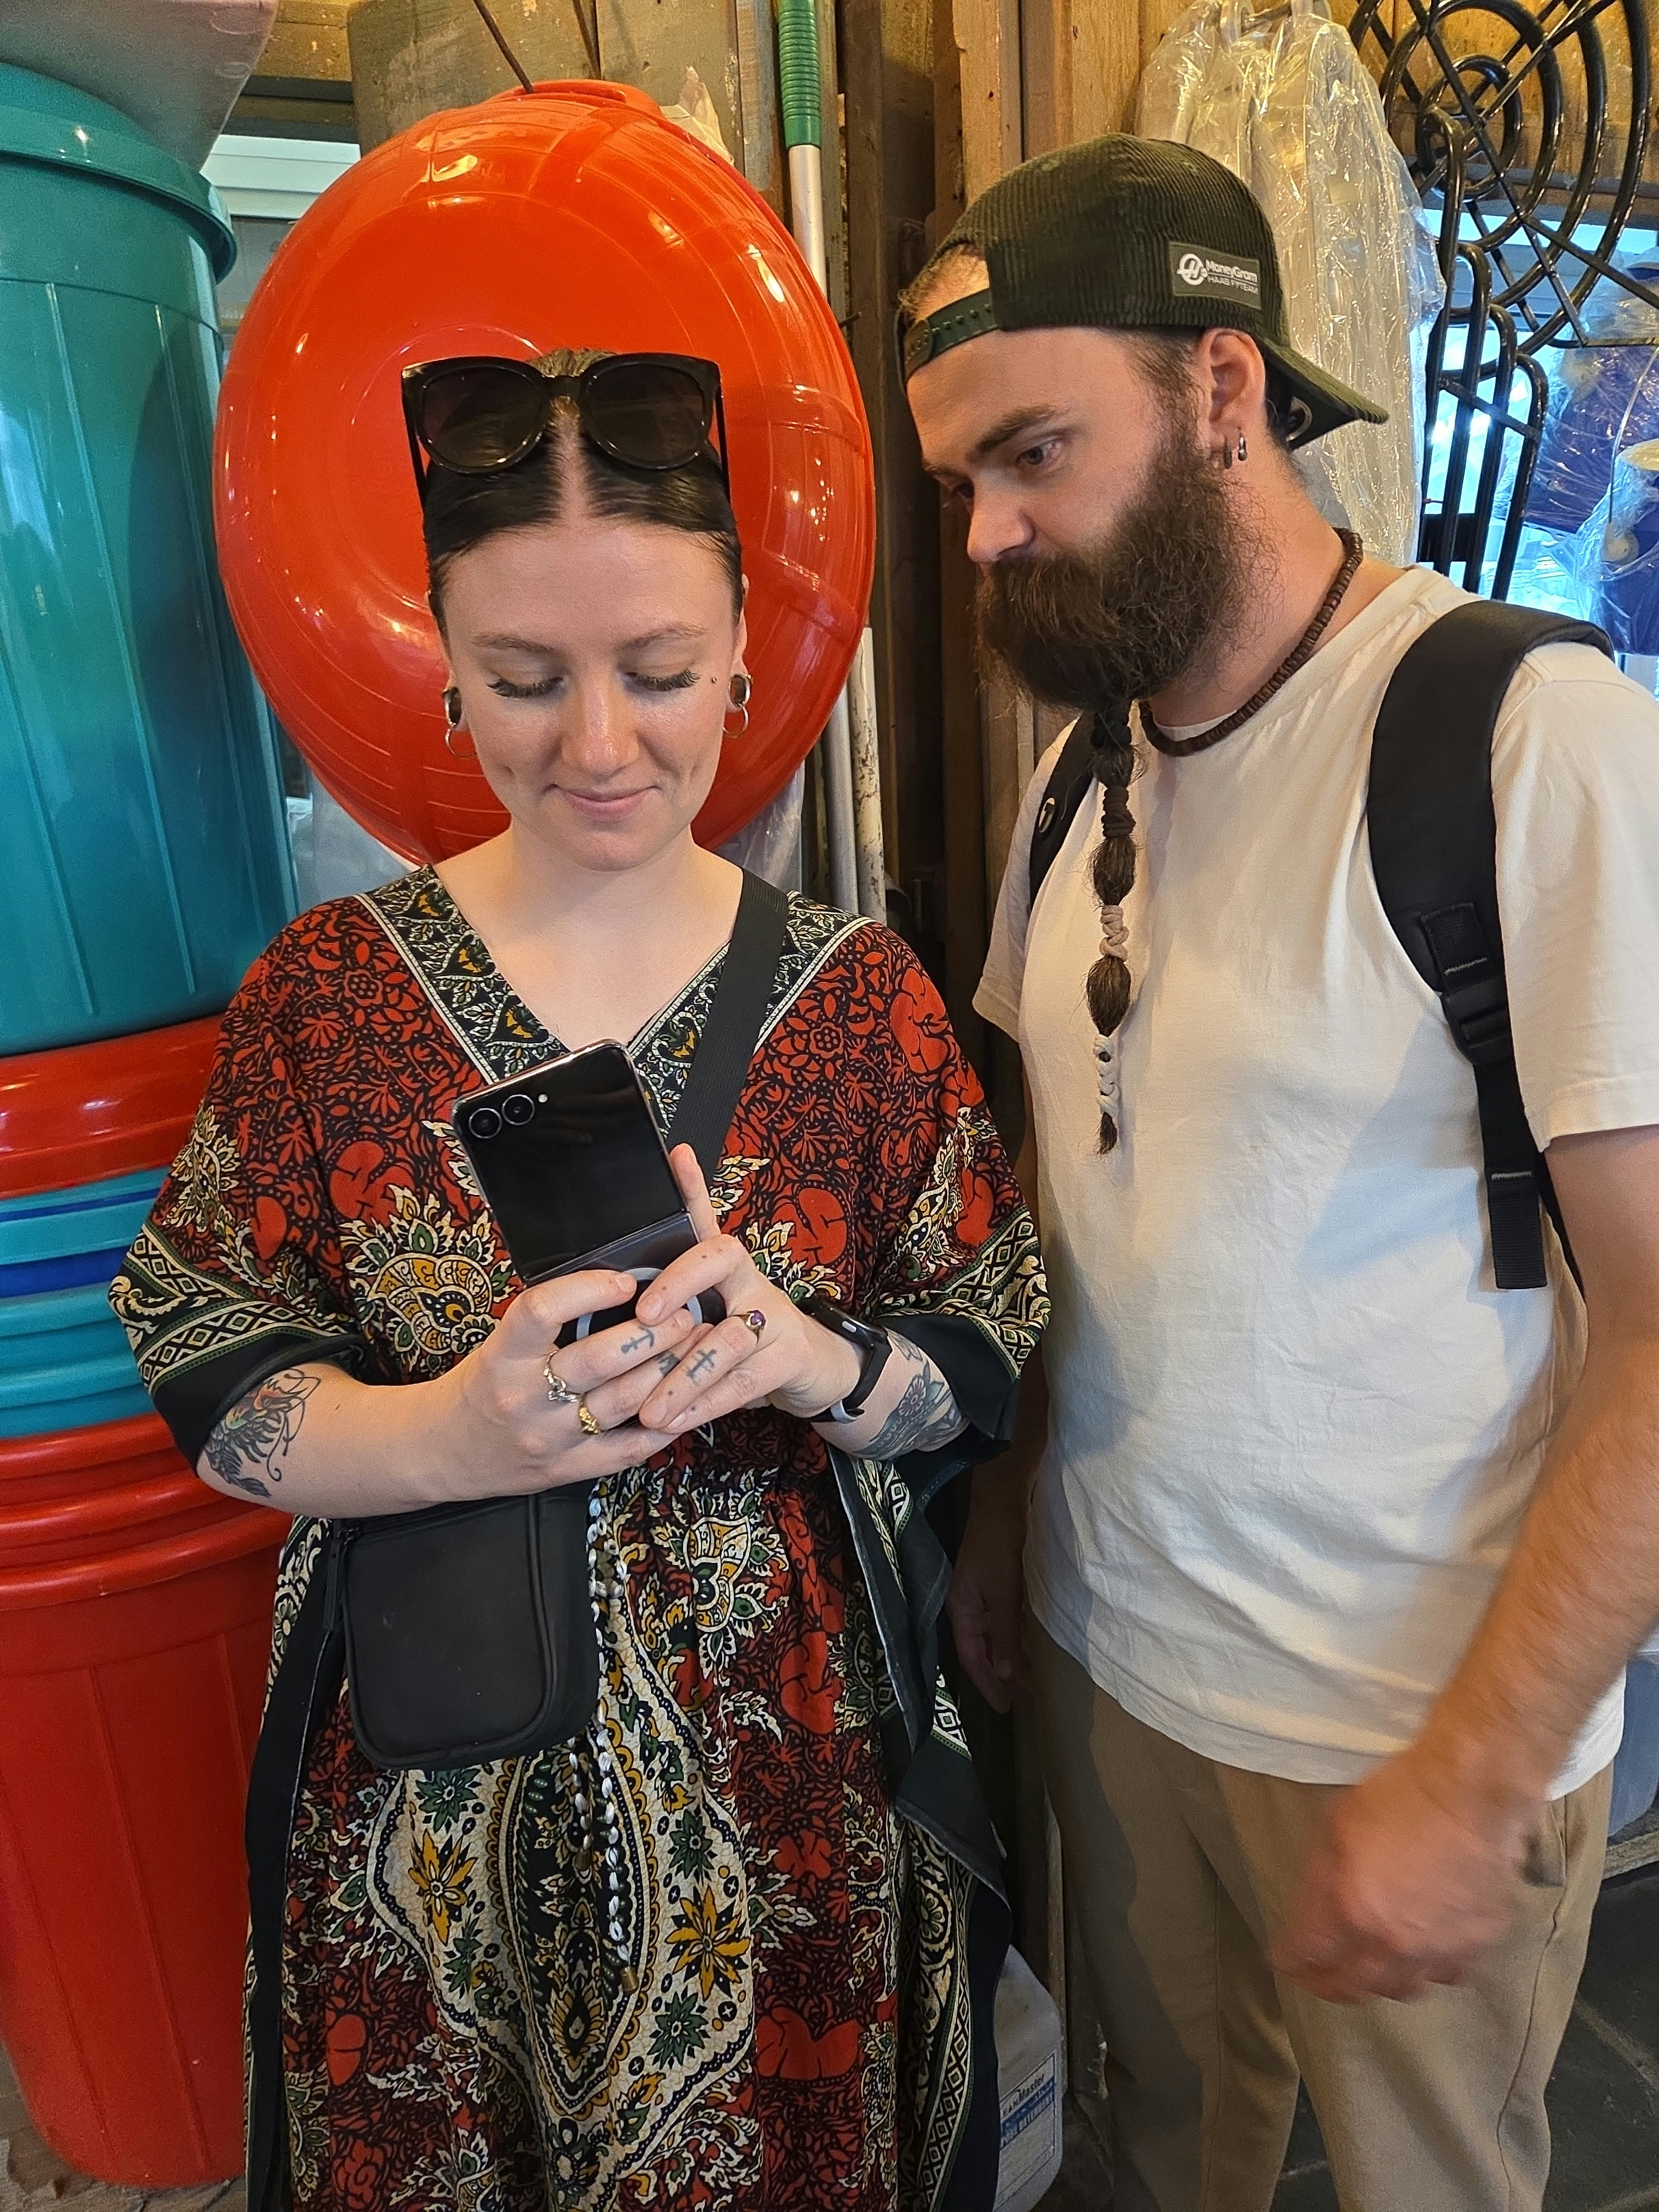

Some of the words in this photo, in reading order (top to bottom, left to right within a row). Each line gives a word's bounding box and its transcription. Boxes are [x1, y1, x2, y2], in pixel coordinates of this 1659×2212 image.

[1206, 259, 1257, 283] MoneyGram
[1207, 275, 1230, 286] HAAS
[1002, 2073, 1045, 2117] EANMaster
